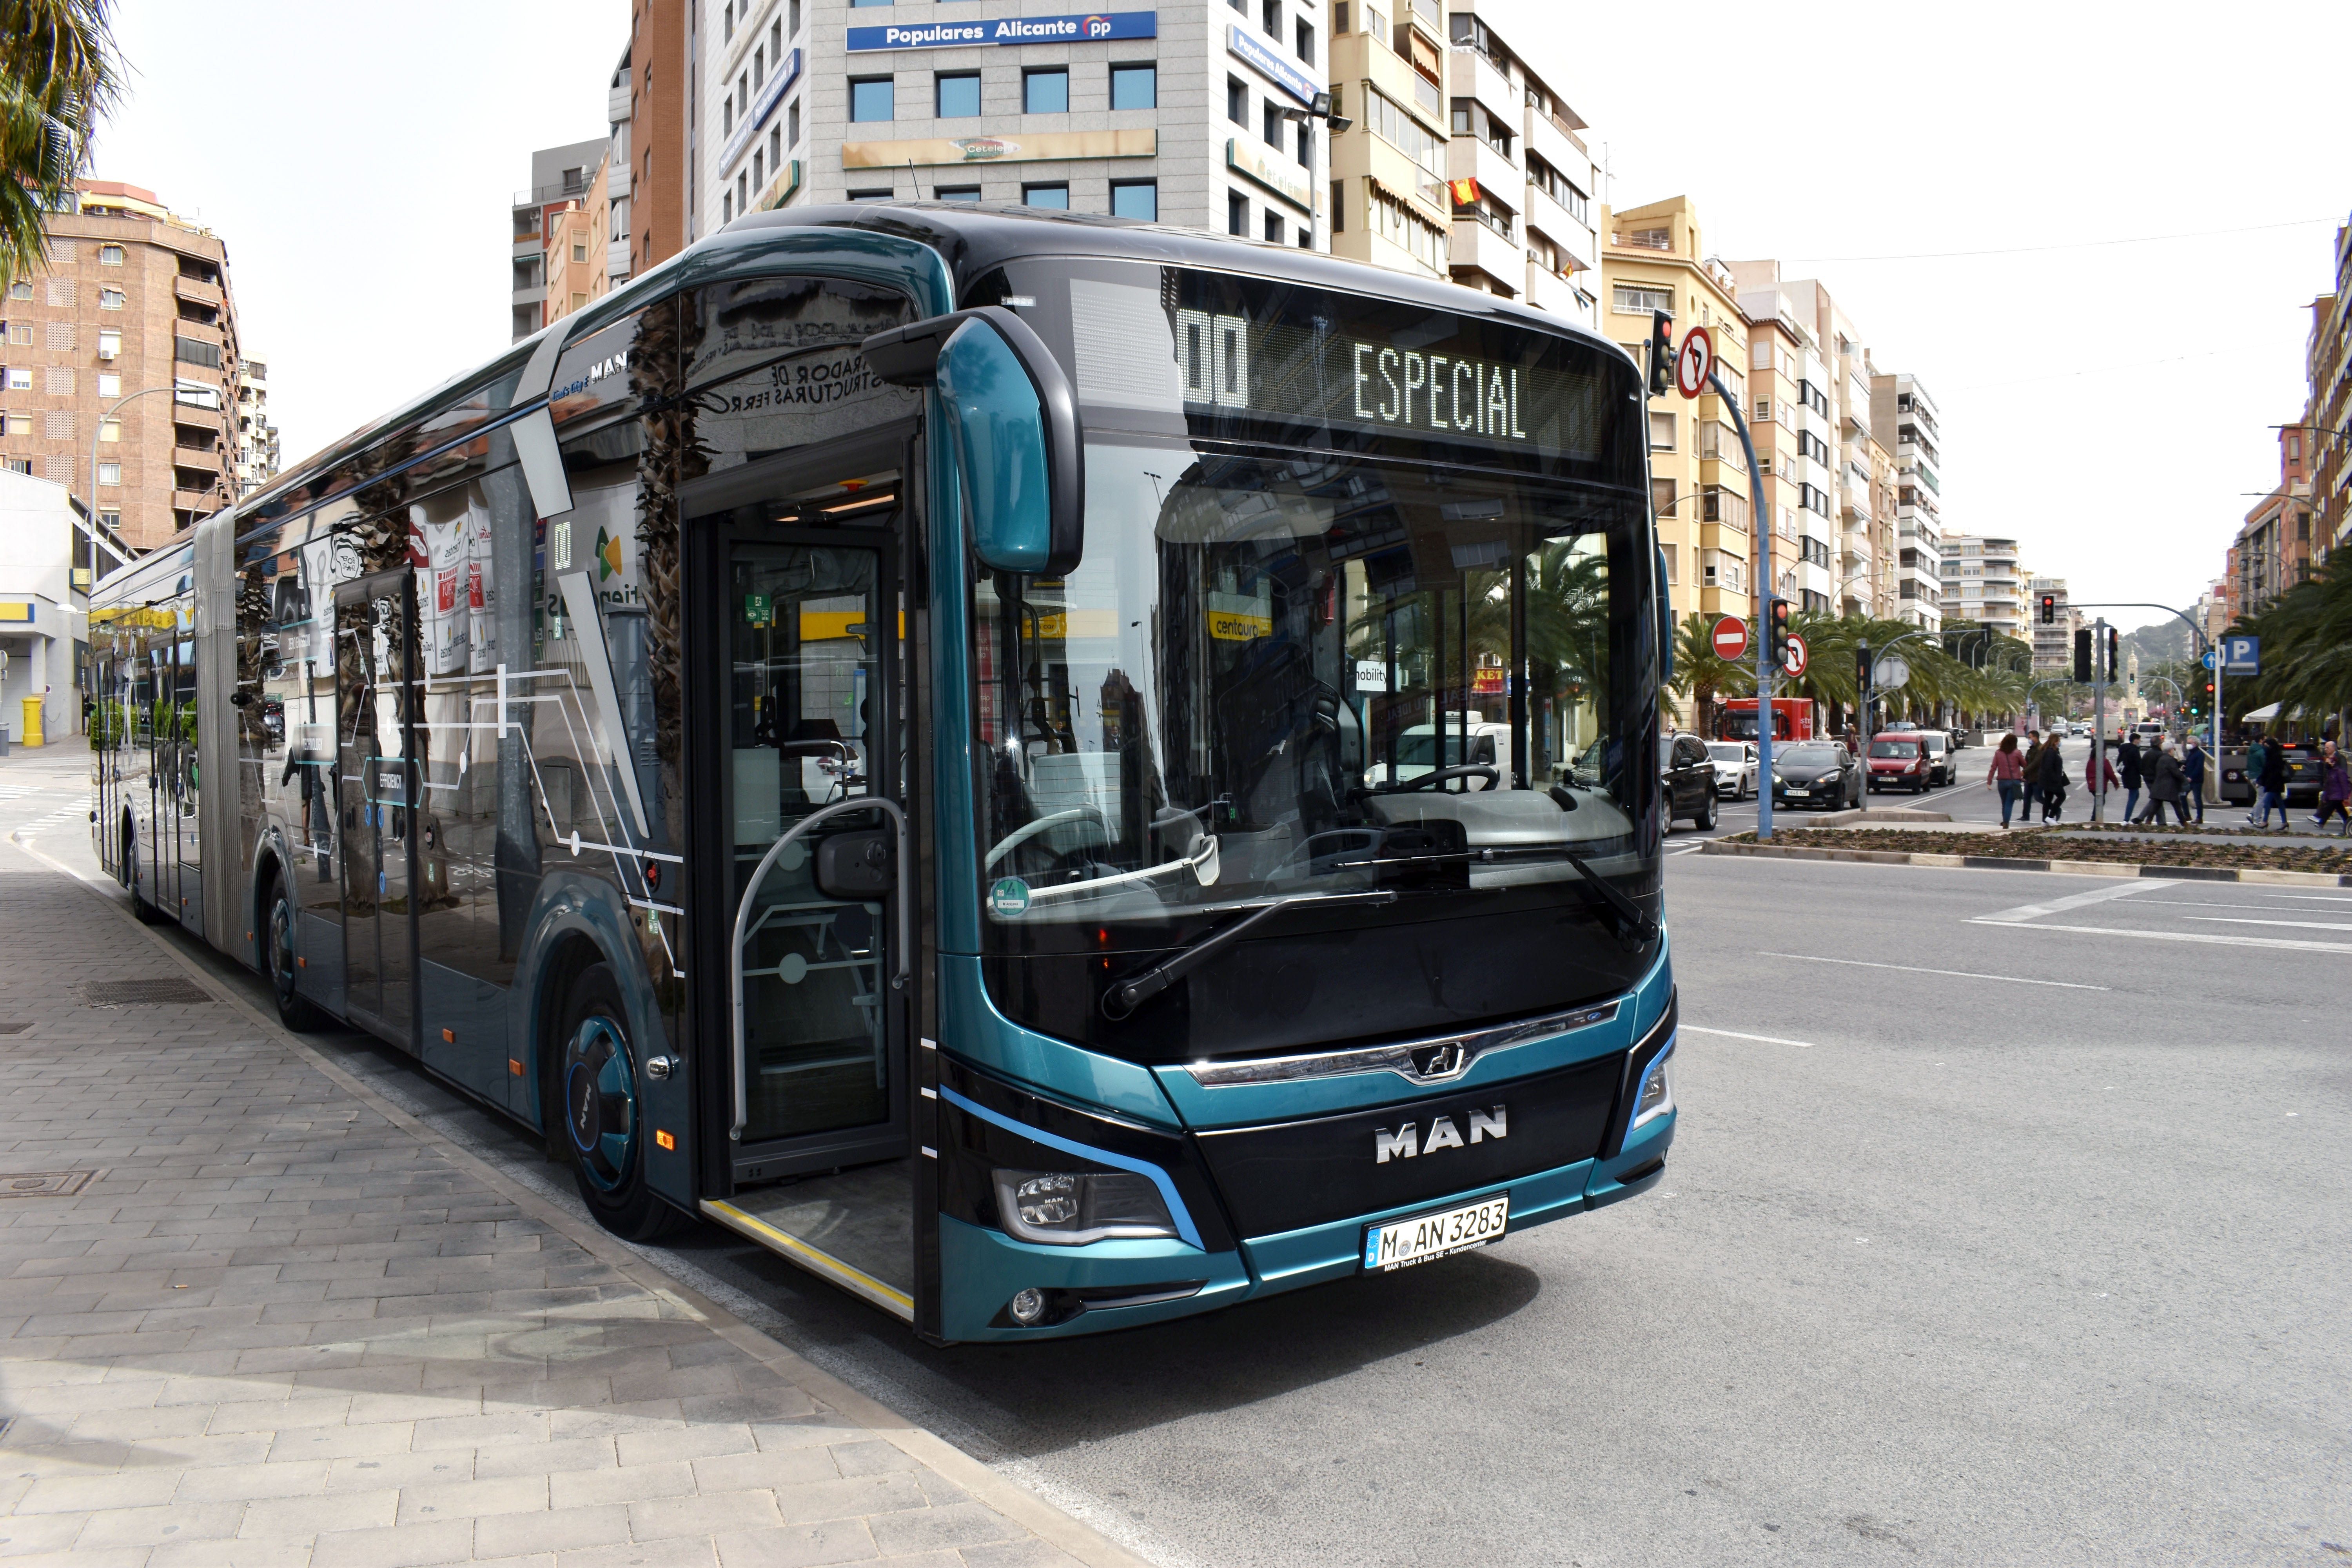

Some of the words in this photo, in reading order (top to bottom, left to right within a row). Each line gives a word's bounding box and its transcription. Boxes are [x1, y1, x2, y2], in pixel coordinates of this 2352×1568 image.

[886, 25, 984, 46] Populares
[995, 19, 1077, 37] Alicante
[1091, 21, 1111, 37] pp
[1238, 34, 1275, 71] Populares
[1274, 62, 1302, 92] Alicante
[591, 351, 628, 384] MAN
[1178, 308, 1248, 408] 00
[1354, 342, 1526, 439] ESPECIAL
[570, 380, 583, 394] City
[1216, 618, 1259, 638] centauro
[2233, 641, 2250, 659] P
[380, 773, 402, 789] EFFICIENCY
[1006, 882, 1016, 898] 4
[580, 1083, 591, 1130] MAN
[1375, 1104, 1506, 1163] MAN
[1381, 1229, 1398, 1260] M
[1414, 1218, 1445, 1252] AN
[1450, 1203, 1505, 1242] 3283
[1368, 1252, 1374, 1262] D
[1384, 1261, 1399, 1272] MAN
[1400, 1256, 1417, 1268] Truck
[1423, 1254, 1435, 1262] Bus
[1436, 1250, 1444, 1259] SE
[1449, 1240, 1487, 1256] Kundencenter
